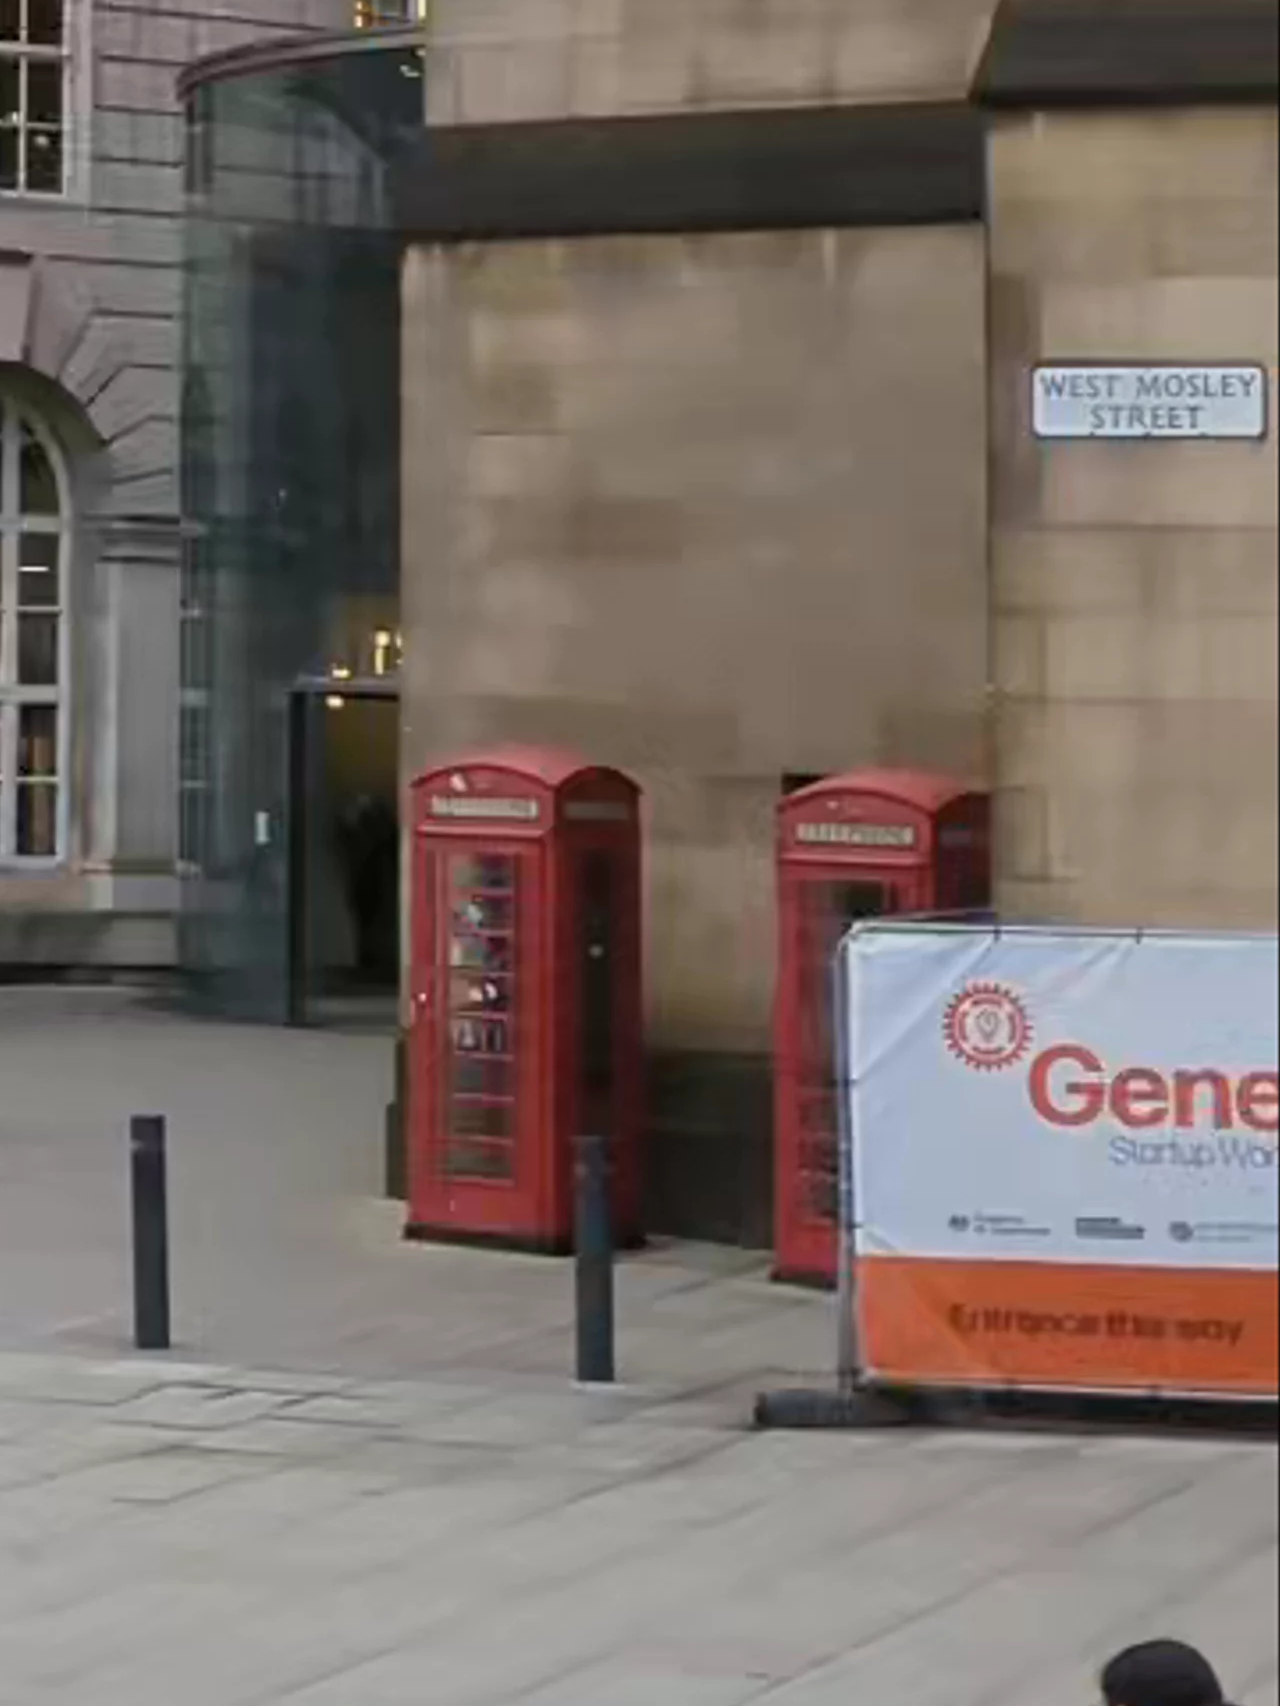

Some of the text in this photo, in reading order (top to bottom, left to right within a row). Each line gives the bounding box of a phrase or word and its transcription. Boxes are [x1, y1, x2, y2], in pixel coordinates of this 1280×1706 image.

[1042, 373, 1255, 399] WEST MOSLEY
[1089, 405, 1205, 430] STREET
[1109, 1136, 1215, 1169] Startup
